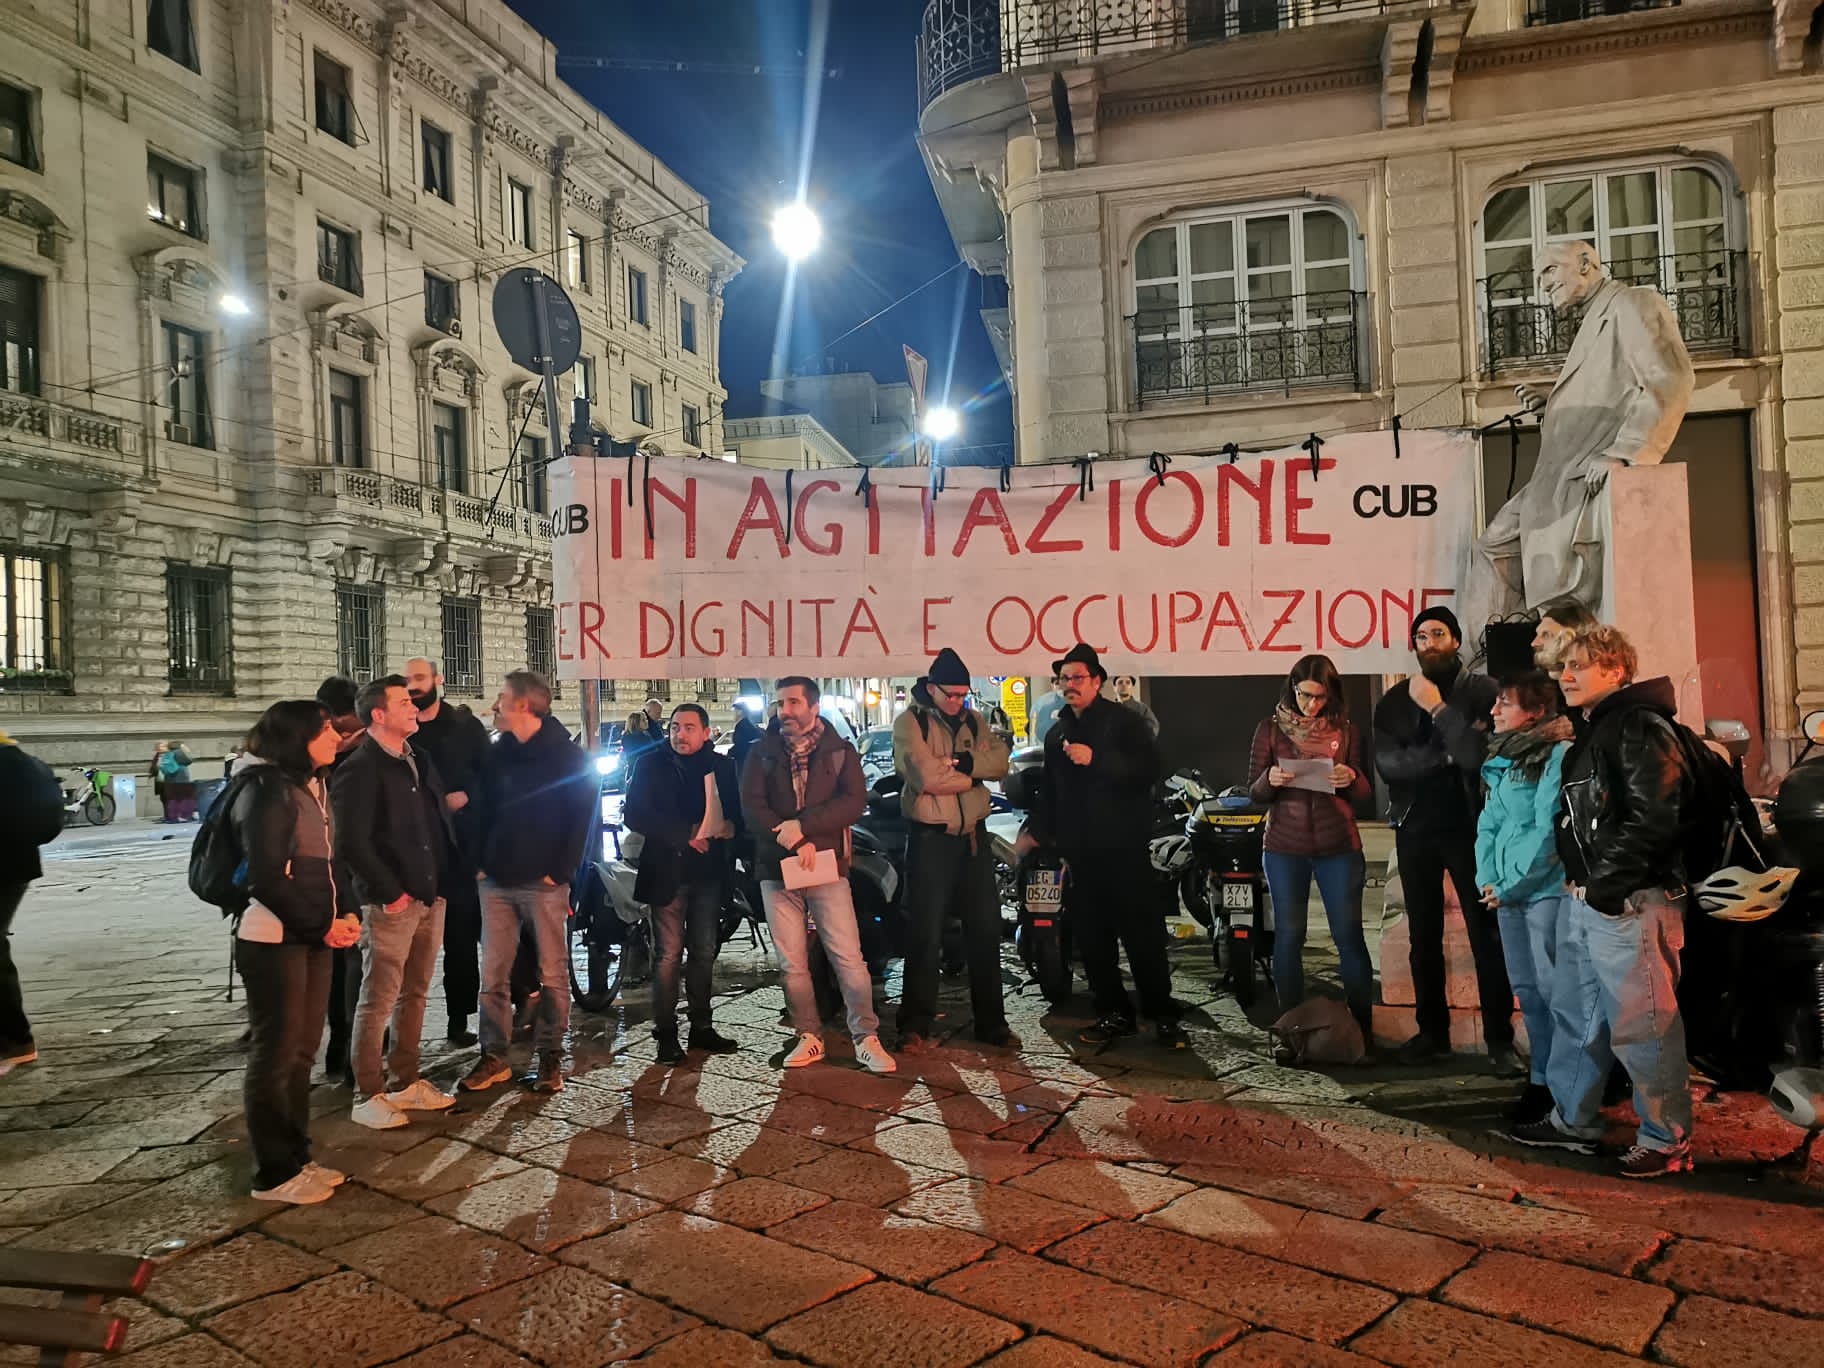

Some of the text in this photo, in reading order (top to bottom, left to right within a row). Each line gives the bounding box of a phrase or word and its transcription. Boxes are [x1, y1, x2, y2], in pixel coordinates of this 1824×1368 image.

[611, 458, 1336, 560] IN AGITAZIONE
[1353, 484, 1438, 518] CUB
[552, 504, 589, 538] CUB
[554, 602, 611, 660] ER
[640, 585, 889, 659] DIGNITÀ
[923, 597, 953, 656] E
[1027, 887, 1060, 900] 05240
